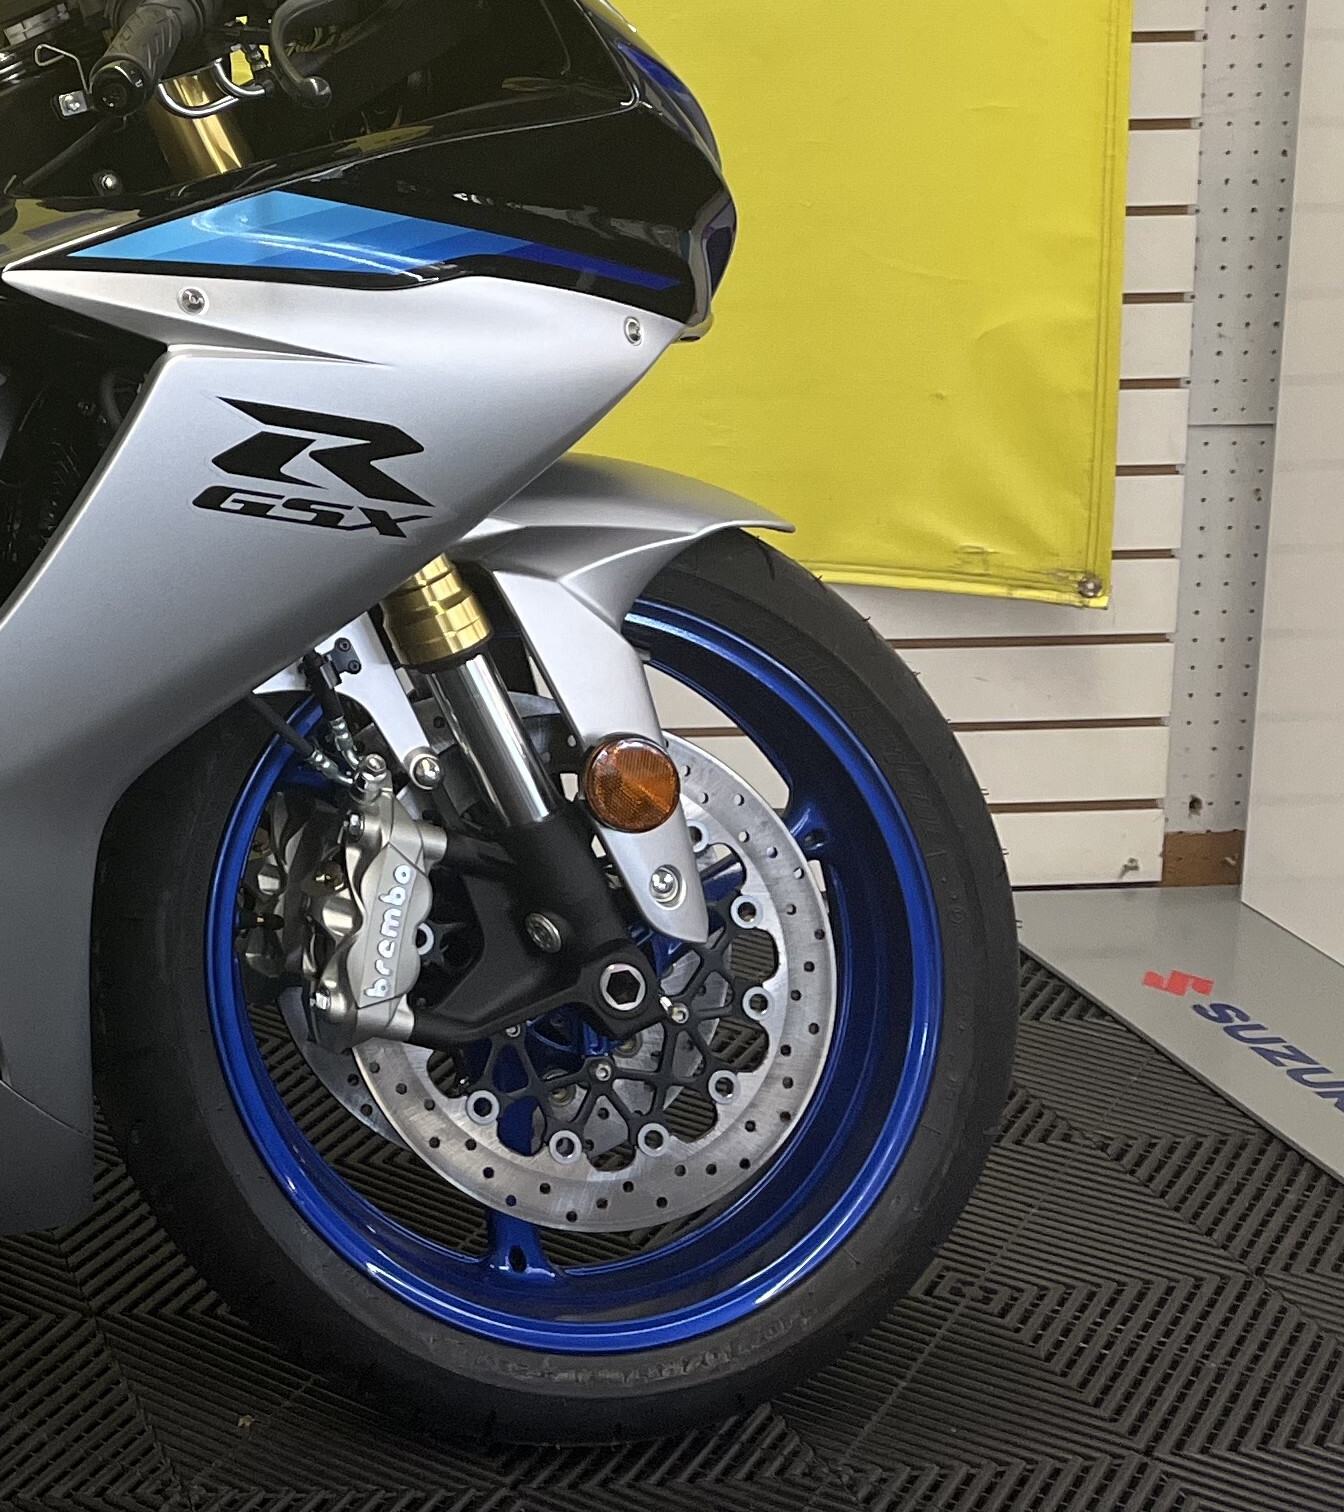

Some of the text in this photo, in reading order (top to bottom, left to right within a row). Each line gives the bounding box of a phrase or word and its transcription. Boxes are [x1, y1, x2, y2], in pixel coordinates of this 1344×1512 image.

[192, 485, 433, 539] GSX
[364, 864, 412, 998] brembo
[1191, 1002, 1344, 1114] SUZU
